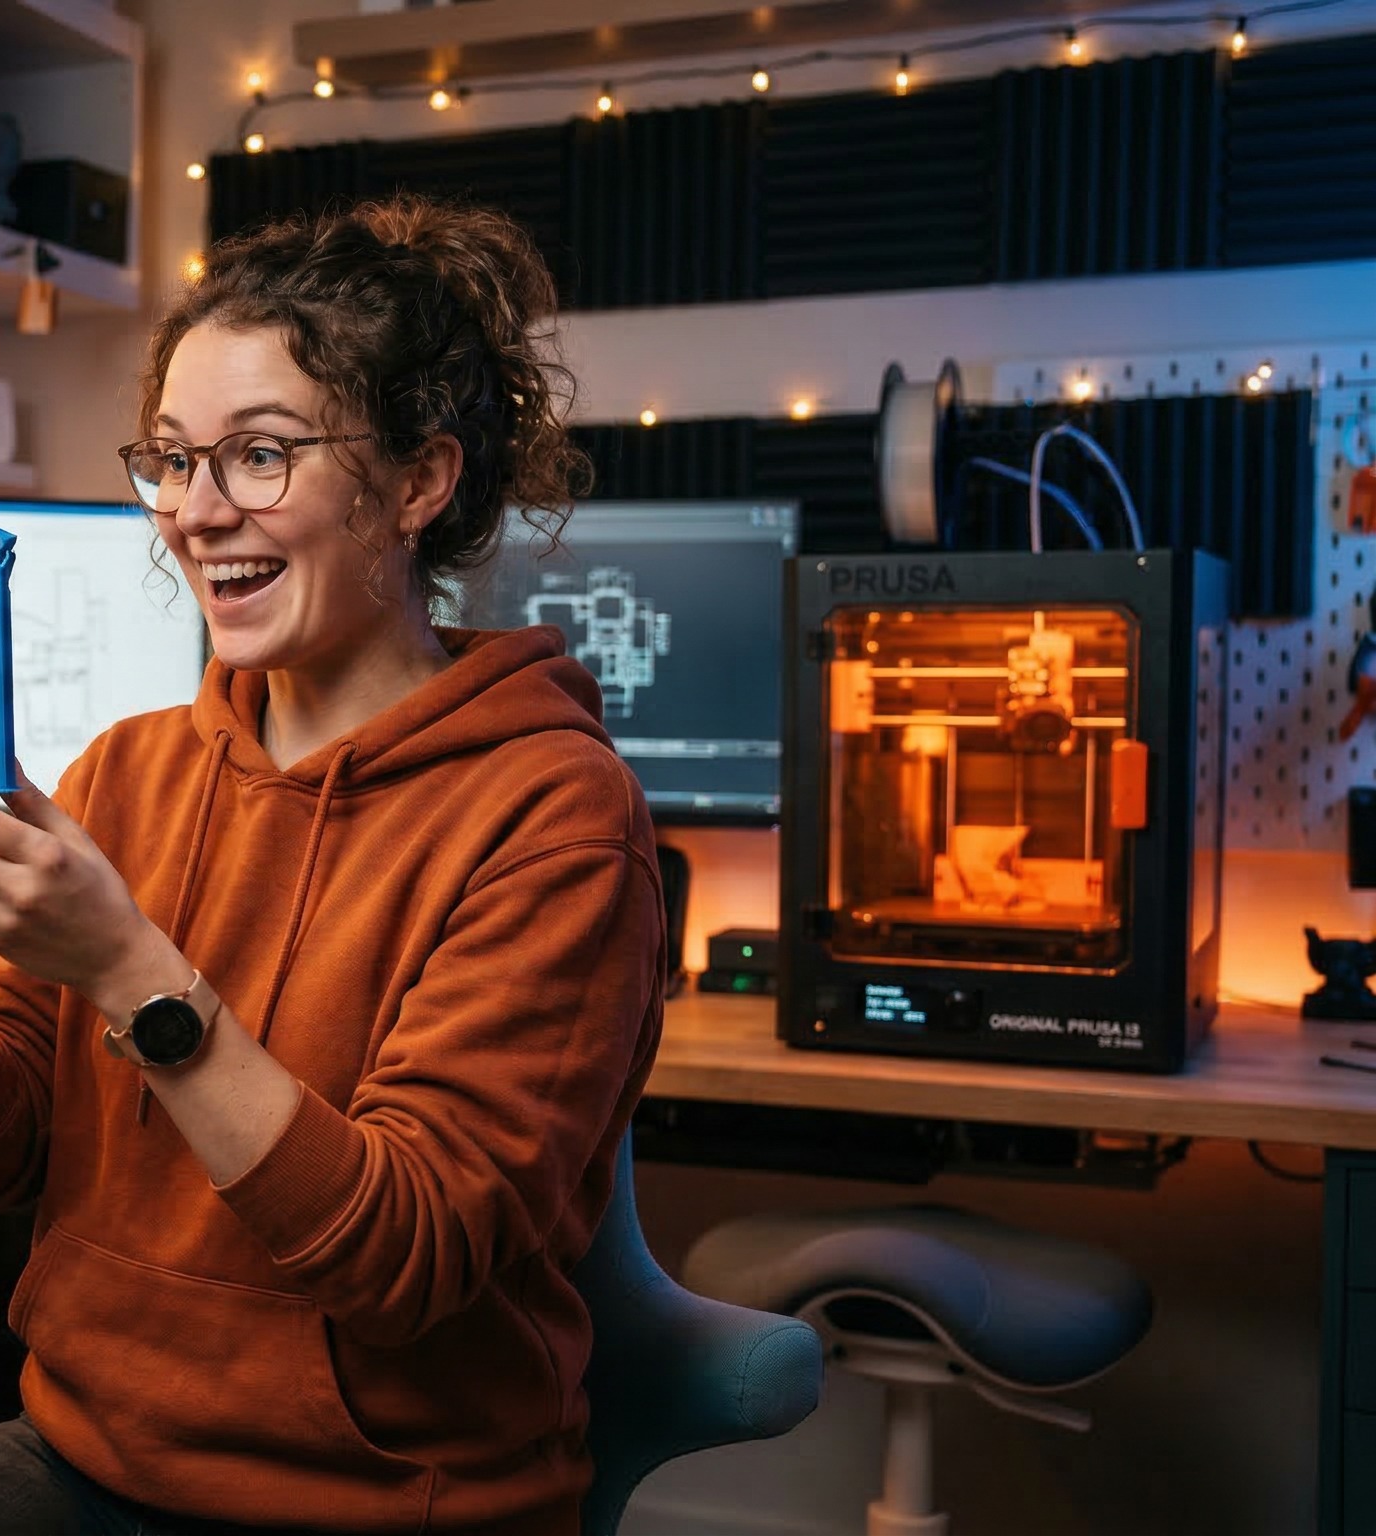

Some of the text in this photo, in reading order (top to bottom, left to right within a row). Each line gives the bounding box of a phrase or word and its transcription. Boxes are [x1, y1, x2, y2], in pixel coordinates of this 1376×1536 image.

[830, 563, 958, 595] PRUSA
[989, 1013, 1064, 1034] ORIGINAL
[1067, 1018, 1122, 1037] PRUSA
